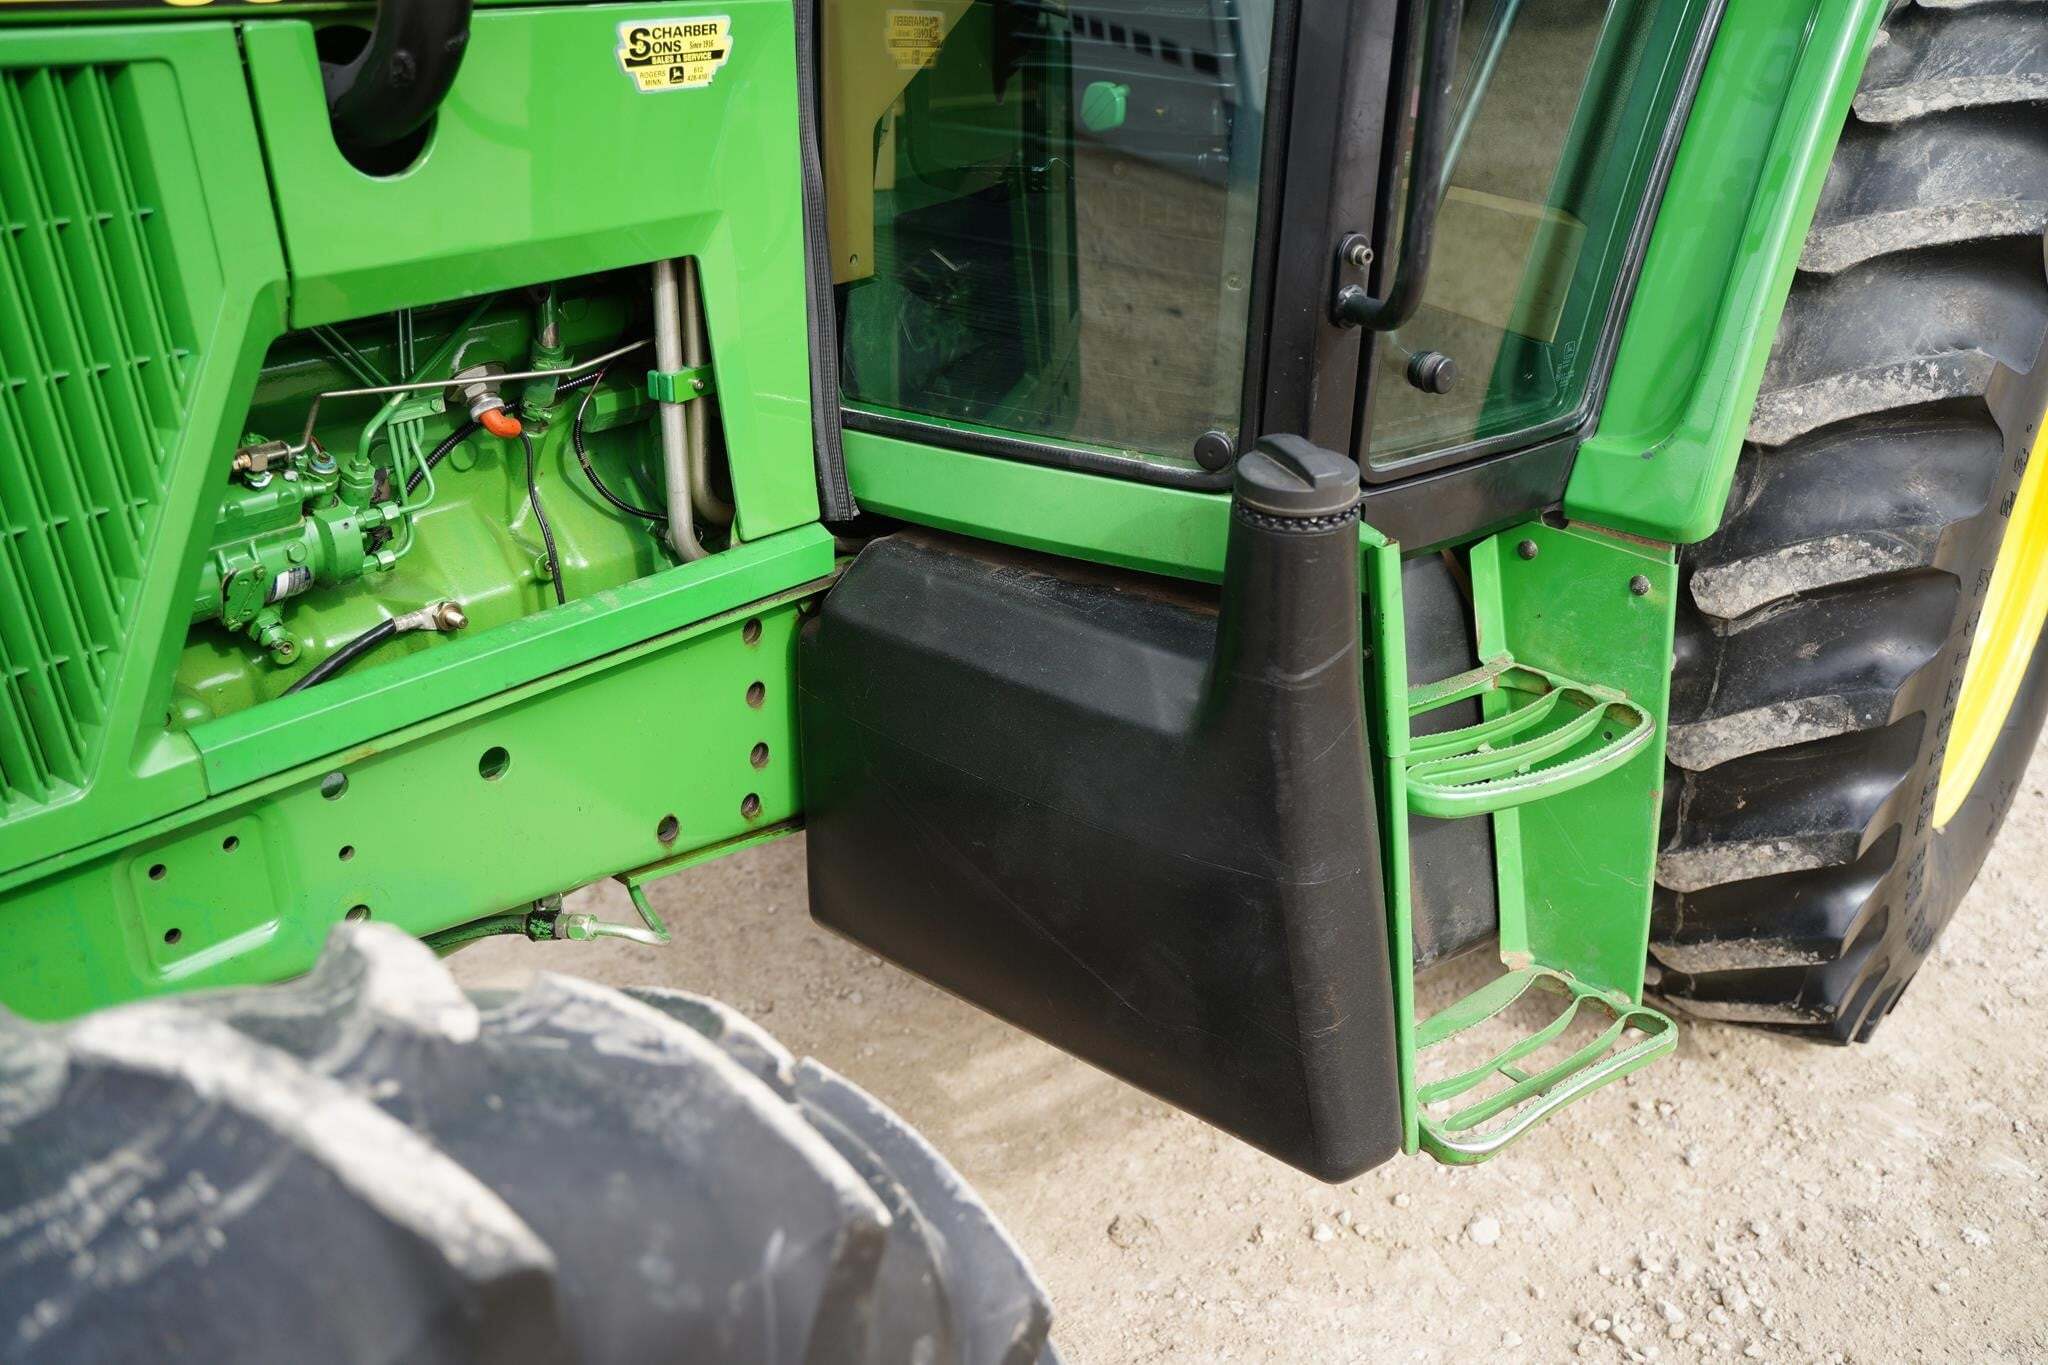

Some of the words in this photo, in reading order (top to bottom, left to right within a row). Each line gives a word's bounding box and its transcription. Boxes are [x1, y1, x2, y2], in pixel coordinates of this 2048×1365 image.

[629, 24, 717, 57] SCHARBER
[652, 56, 674, 65] SALES
[683, 52, 712, 62] SERVICE
[640, 70, 666, 79] ROGERS
